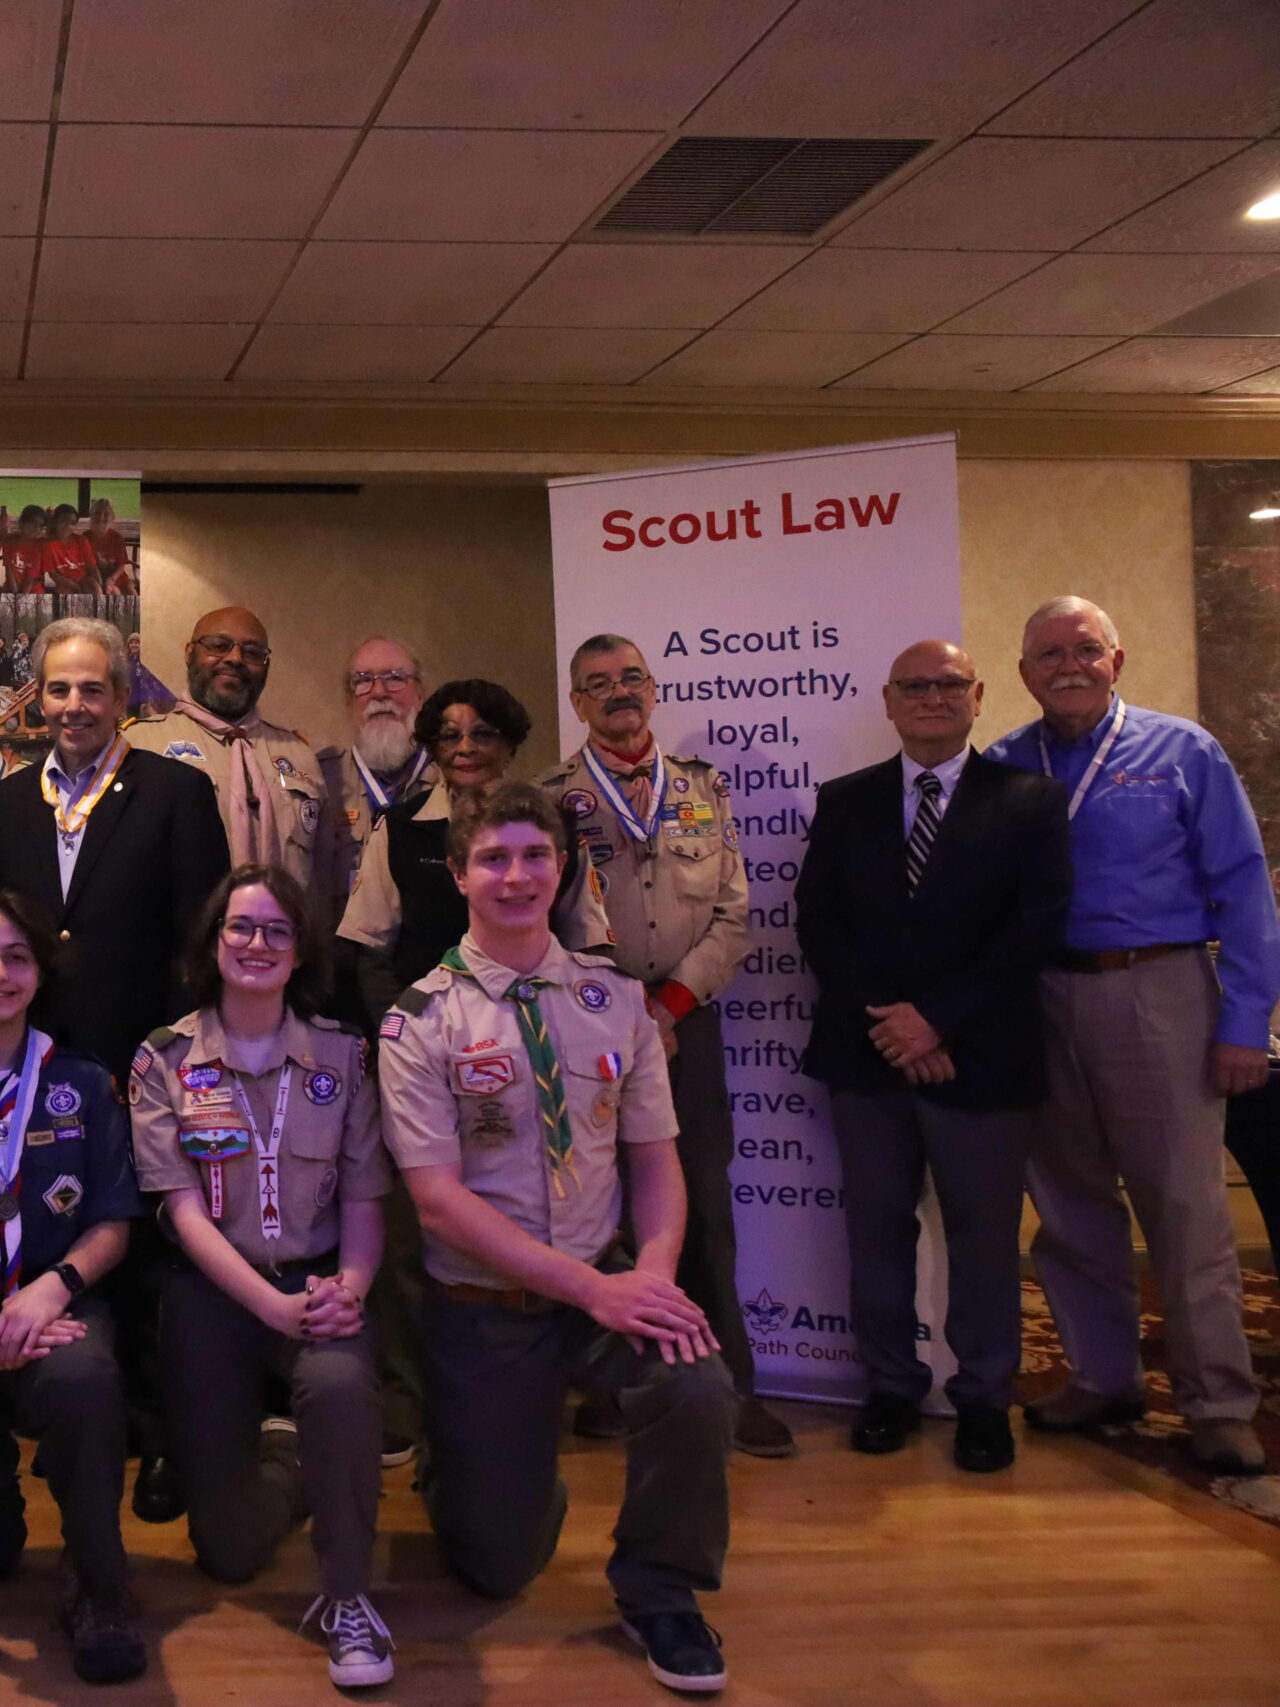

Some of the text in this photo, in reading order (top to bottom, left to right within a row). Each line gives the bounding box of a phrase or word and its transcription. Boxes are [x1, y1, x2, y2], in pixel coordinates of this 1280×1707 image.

[602, 491, 901, 552] Scout Law
[663, 621, 839, 658] A Scout is
[708, 716, 799, 752] loyal,
[717, 762, 820, 797] elpful,
[475, 1039, 499, 1051] BSA
[730, 1091, 815, 1119] rave,
[737, 1138, 814, 1166] ean,
